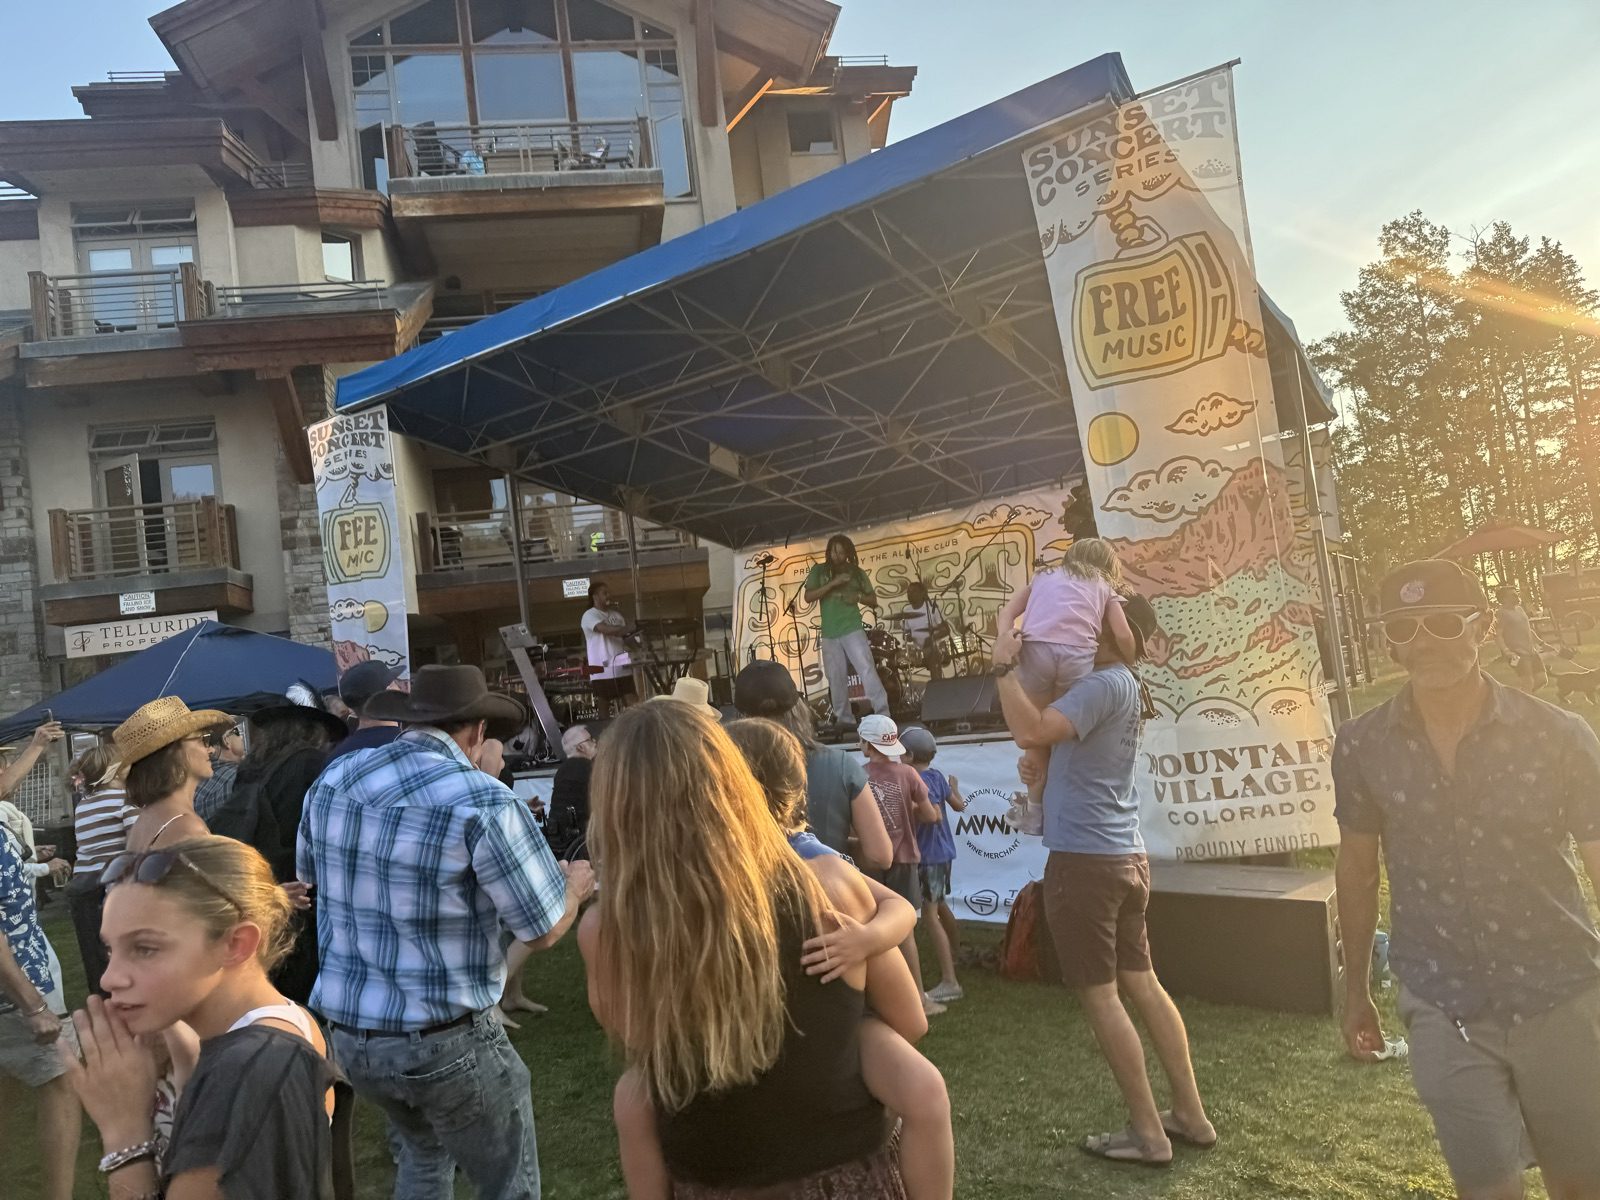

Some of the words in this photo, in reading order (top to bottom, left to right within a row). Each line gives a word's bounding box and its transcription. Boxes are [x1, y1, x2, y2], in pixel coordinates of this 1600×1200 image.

[1029, 75, 1227, 179] SUNSET
[1036, 111, 1227, 207] CONCERT
[1075, 149, 1180, 198] SERIES
[1088, 265, 1187, 336] FREE
[1102, 325, 1187, 363] MUSIC
[310, 410, 385, 449] SUNSET
[870, 553, 888, 563] THE
[893, 547, 930, 559] ALINE
[934, 539, 959, 551] CLUB
[748, 541, 1014, 632] SUSET
[992, 788, 1015, 807] VILLA
[1154, 768, 1331, 804] VILLAGE,
[1168, 799, 1316, 826] COLORADO
[966, 840, 983, 857] WINE
[984, 838, 1020, 860] MERCHANT
[1176, 840, 1247, 860] PROUDLY
[1255, 832, 1320, 853] FUNDED
